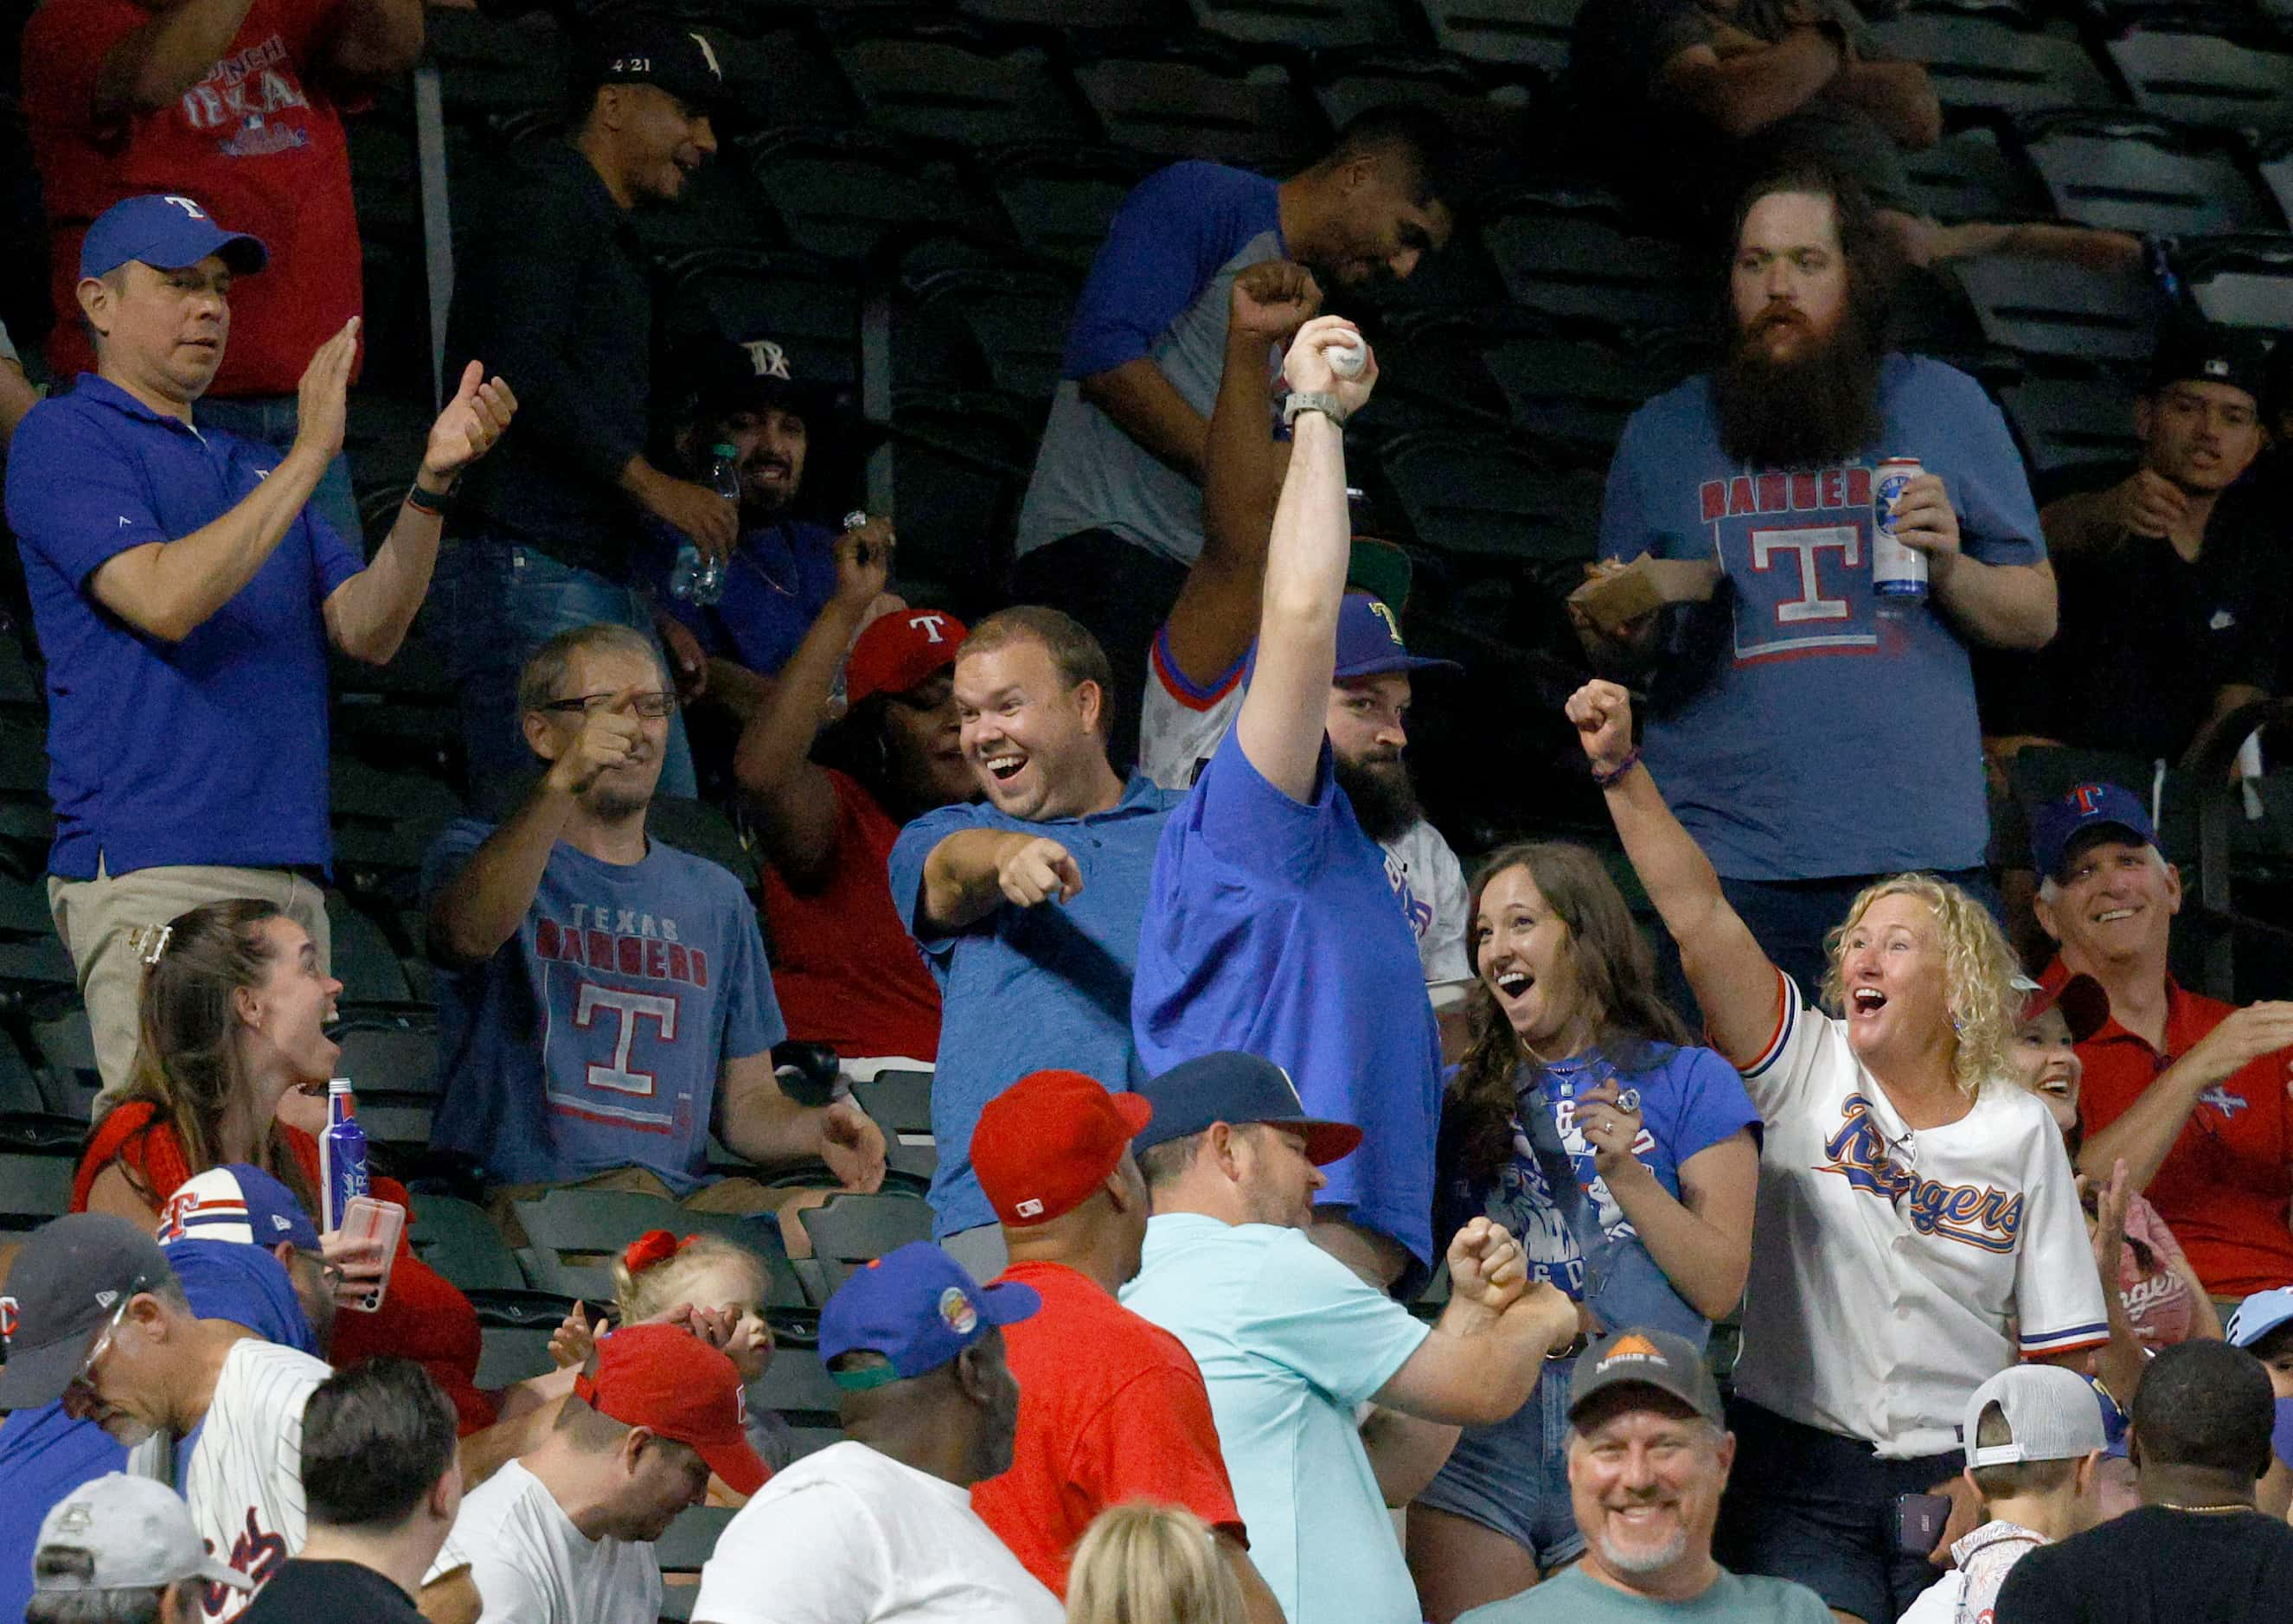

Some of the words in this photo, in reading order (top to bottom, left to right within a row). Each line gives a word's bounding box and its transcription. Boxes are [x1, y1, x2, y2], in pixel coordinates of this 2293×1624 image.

[163, 196, 207, 221] T
[1749, 521, 1864, 626] T
[909, 615, 944, 643] T
[1368, 601, 1403, 646] T
[2064, 785, 2103, 816] T
[570, 903, 679, 941] TEXAS
[571, 979, 680, 1097] T
[161, 1192, 199, 1241] T
